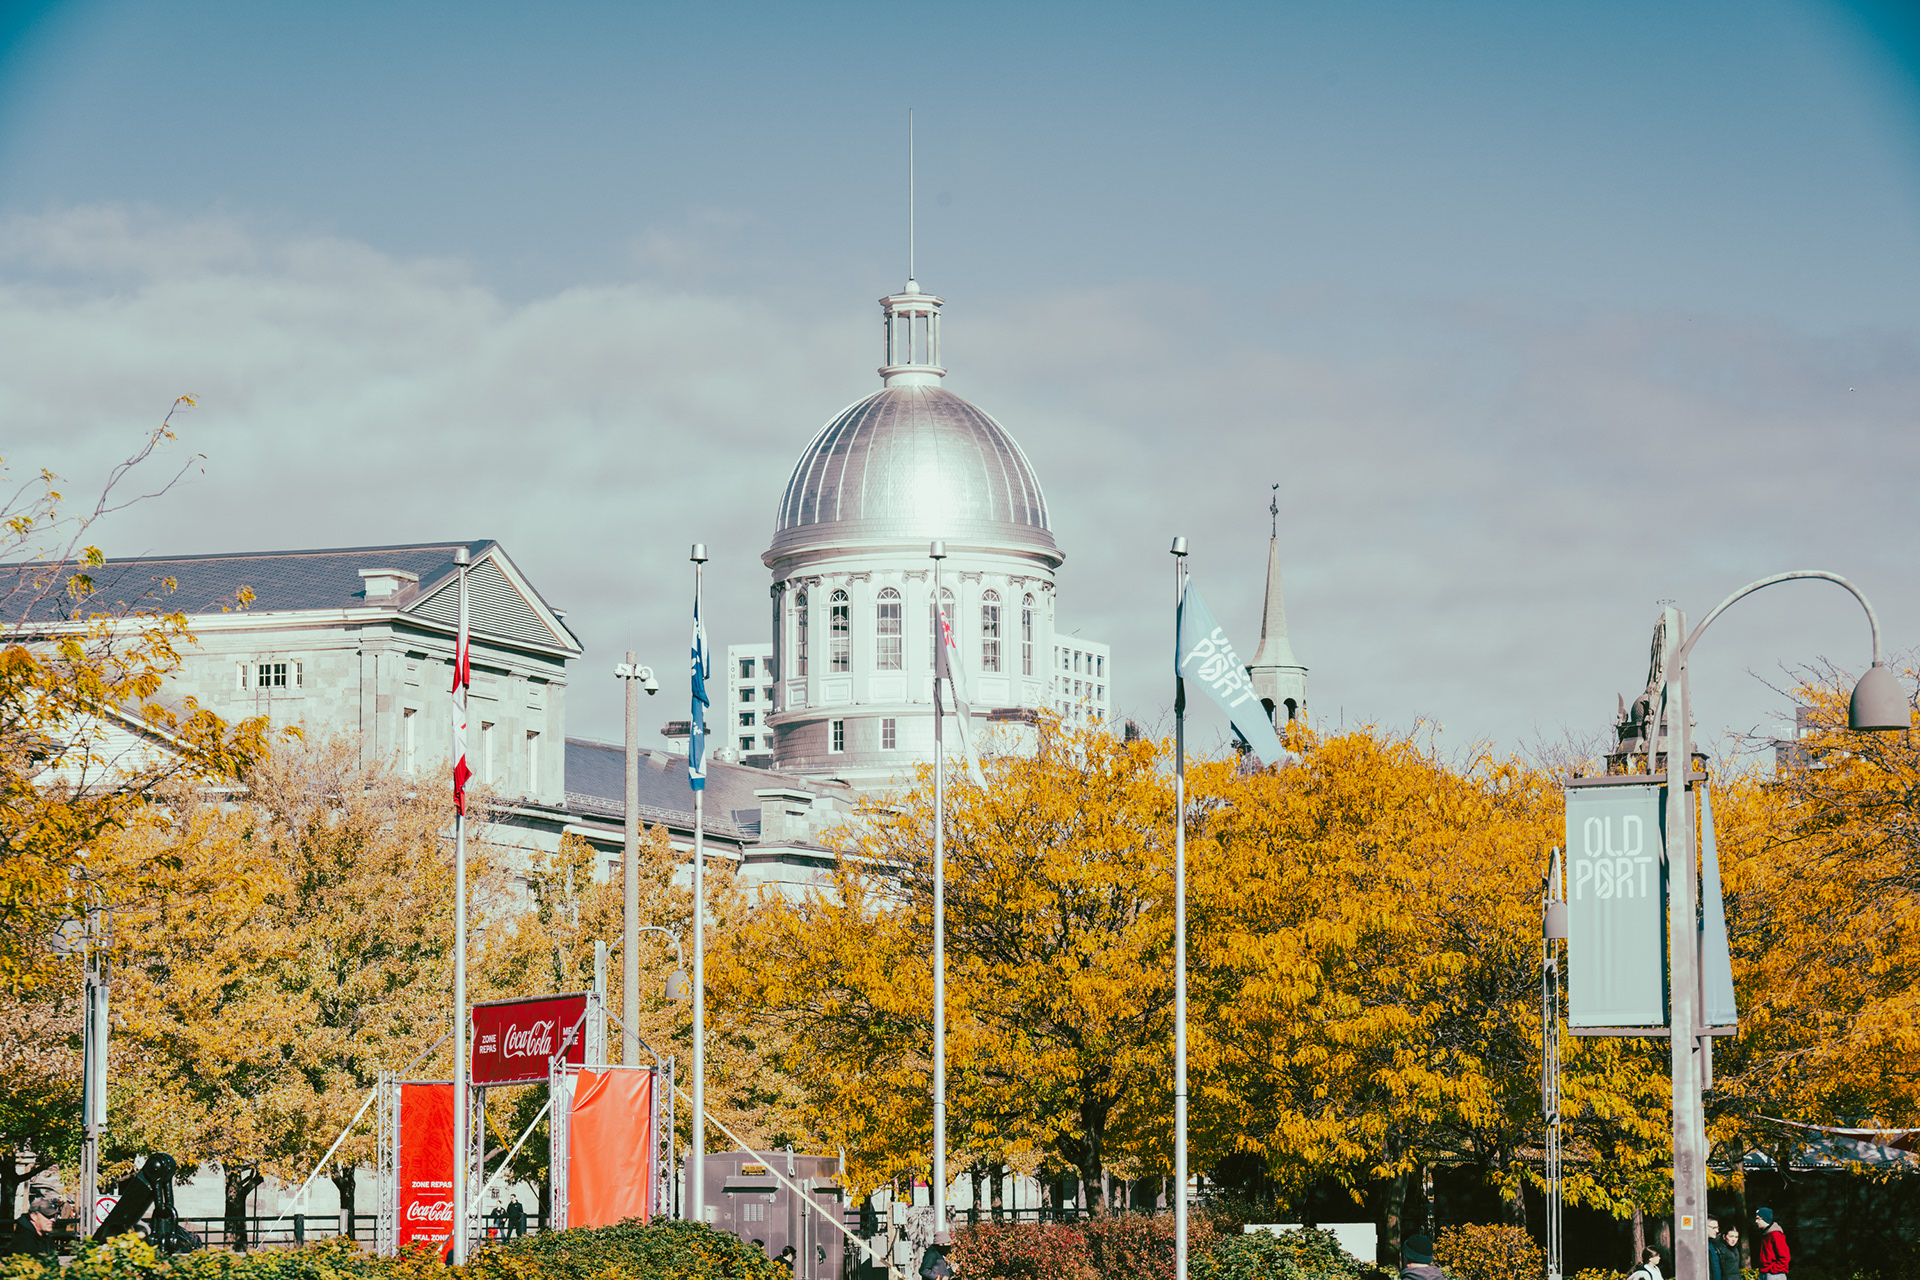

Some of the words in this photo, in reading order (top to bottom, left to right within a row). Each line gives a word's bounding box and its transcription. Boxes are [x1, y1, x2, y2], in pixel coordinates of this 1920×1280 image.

[1181, 637, 1257, 708] PORT
[1584, 815, 1643, 857] OLD
[1576, 856, 1652, 900] PORT
[479, 1044, 496, 1054] REPAS
[482, 1034, 497, 1043] ZONE
[503, 1020, 555, 1058] Coca-Cola
[407, 1200, 454, 1221] Coca-Cola
